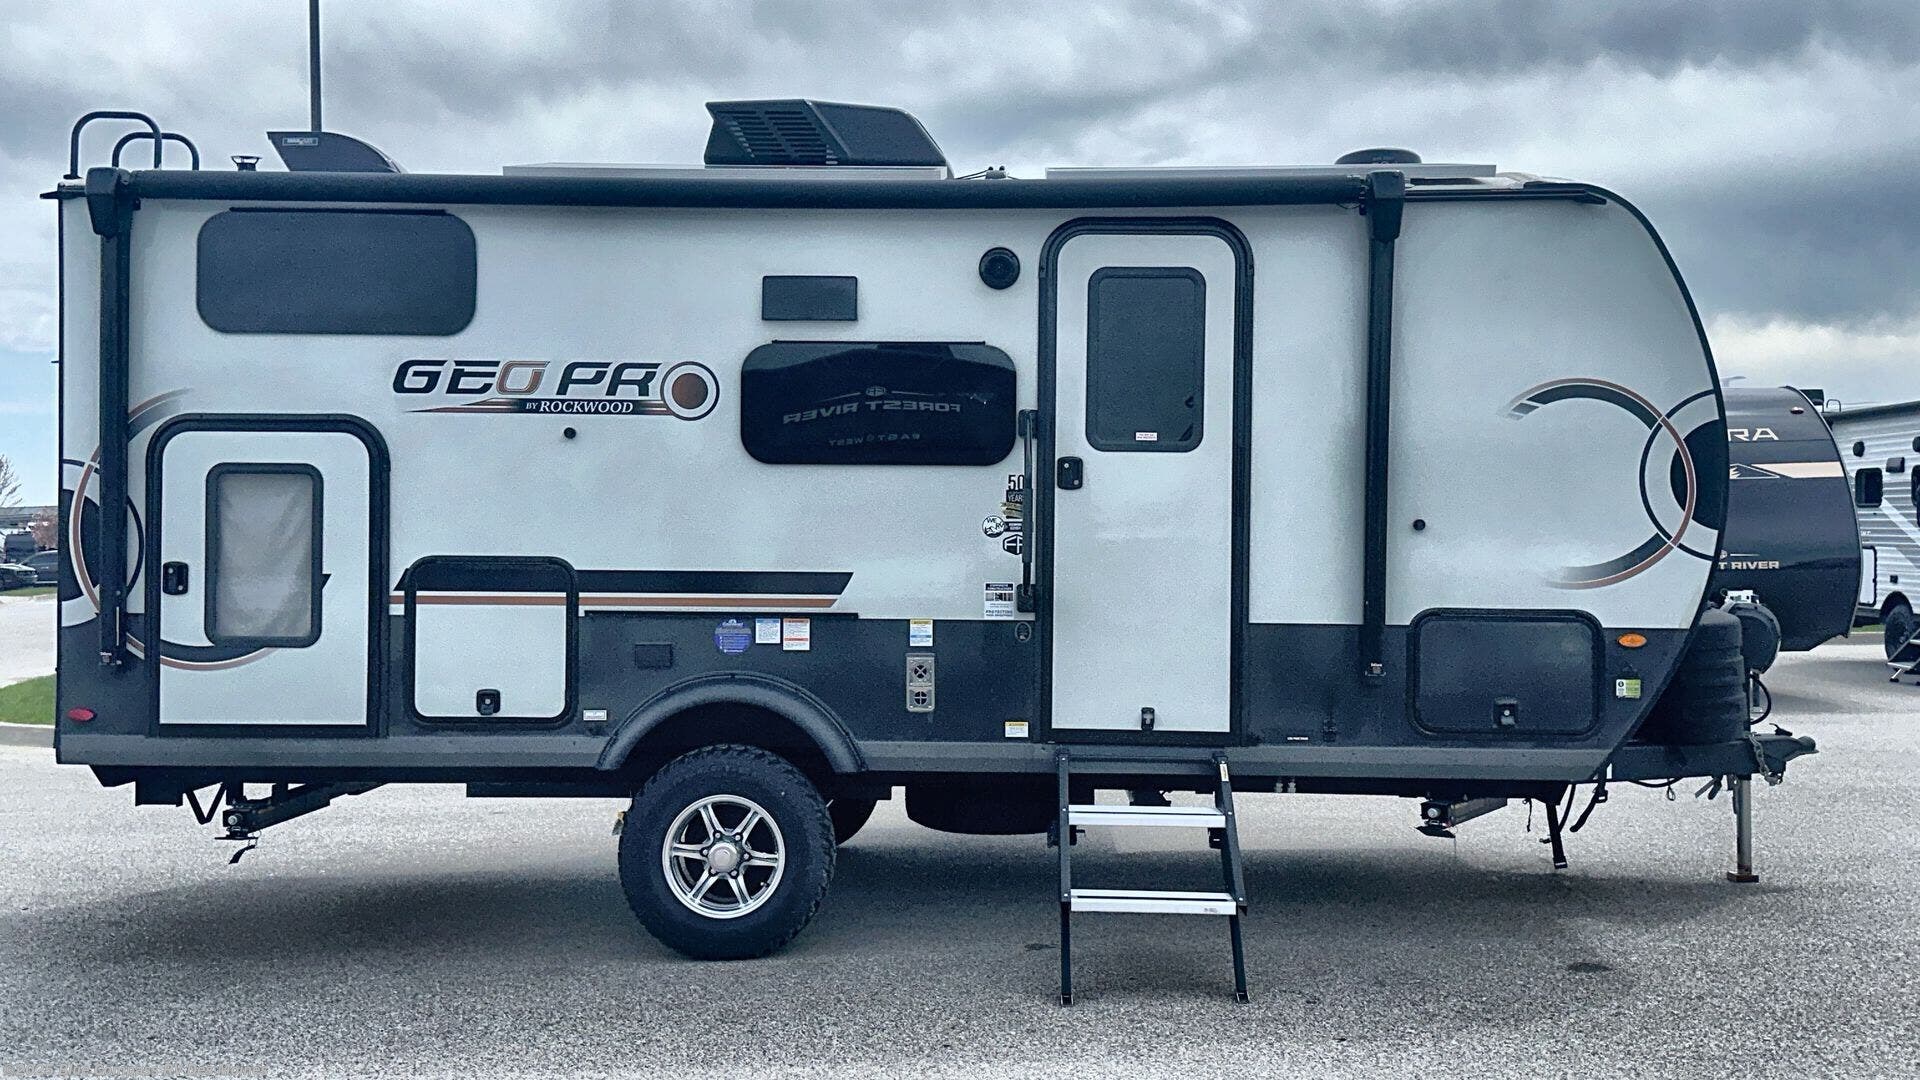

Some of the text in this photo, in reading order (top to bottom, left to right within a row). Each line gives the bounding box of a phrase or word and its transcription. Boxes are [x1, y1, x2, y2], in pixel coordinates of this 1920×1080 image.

[392, 360, 551, 395] GEO
[525, 401, 634, 414] BY ROCKWOOD
[1008, 474, 1025, 491] 50
[1731, 561, 1780, 570] RIVER
